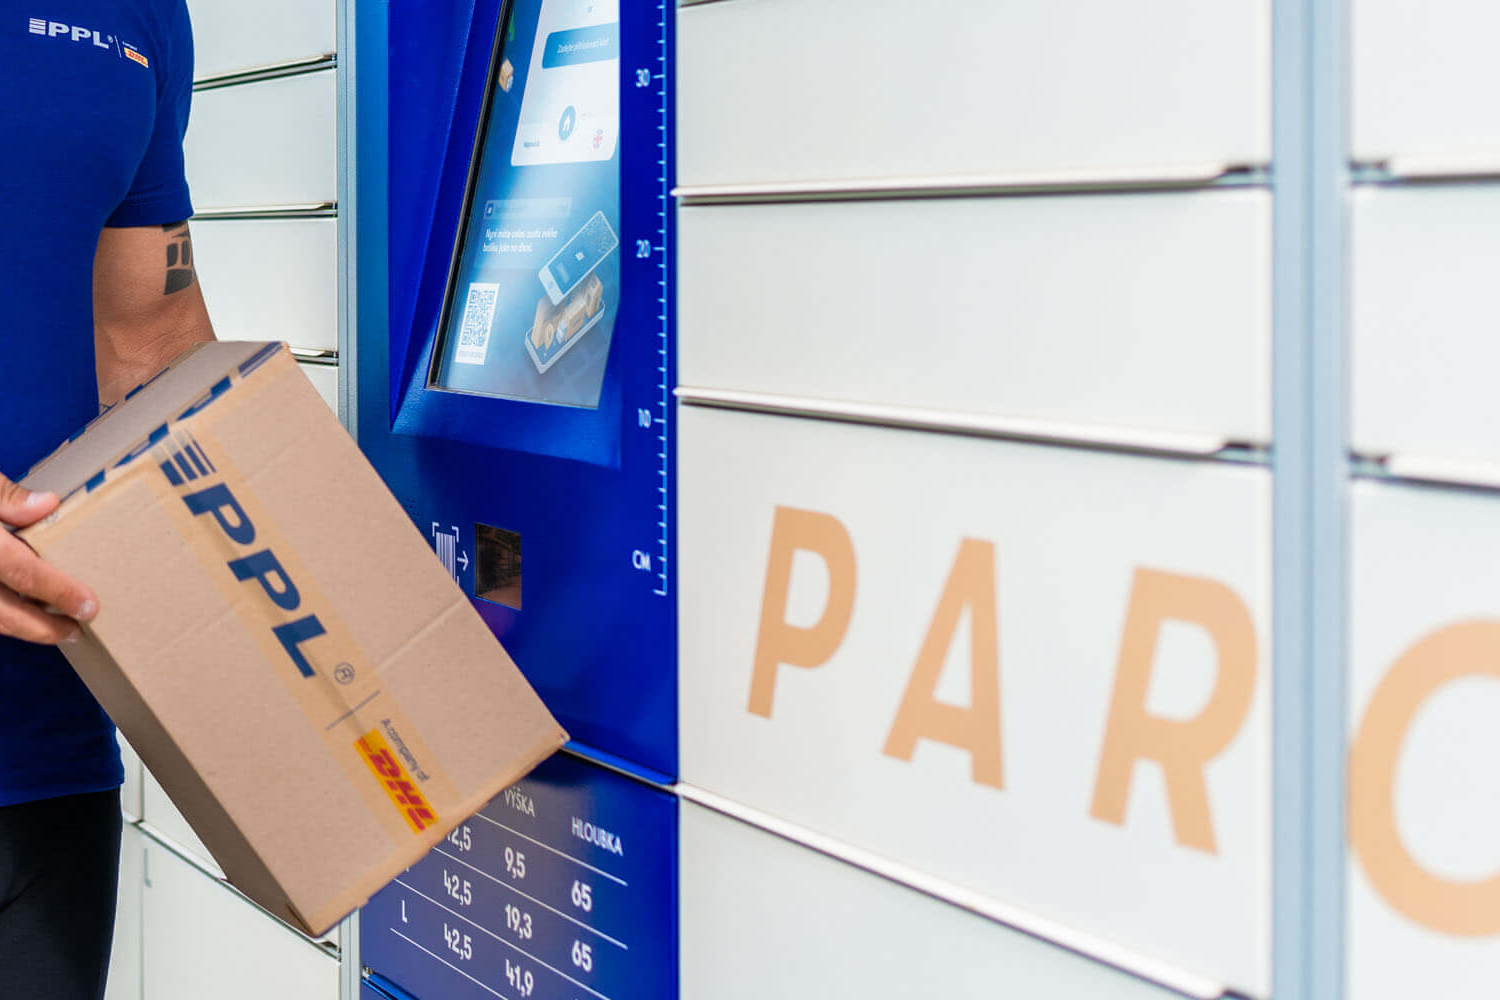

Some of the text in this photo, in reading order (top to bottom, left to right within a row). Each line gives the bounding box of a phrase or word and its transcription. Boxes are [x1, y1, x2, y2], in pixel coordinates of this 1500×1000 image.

[48, 21, 109, 49] PPL
[635, 68, 650, 87] 30
[636, 239, 650, 258] 20
[638, 408, 652, 428] 10
[632, 549, 651, 571] CM
[182, 483, 327, 679] PPL
[368, 749, 434, 831] DHL
[504, 785, 536, 818] VÝŠKA
[572, 815, 624, 857] HLOUBKA
[447, 824, 593, 912] 2,5 9,5 65
[443, 869, 593, 972] 42,5 19,3 65
[443, 922, 473, 960] 42,5
[505, 958, 535, 998] 41,9
